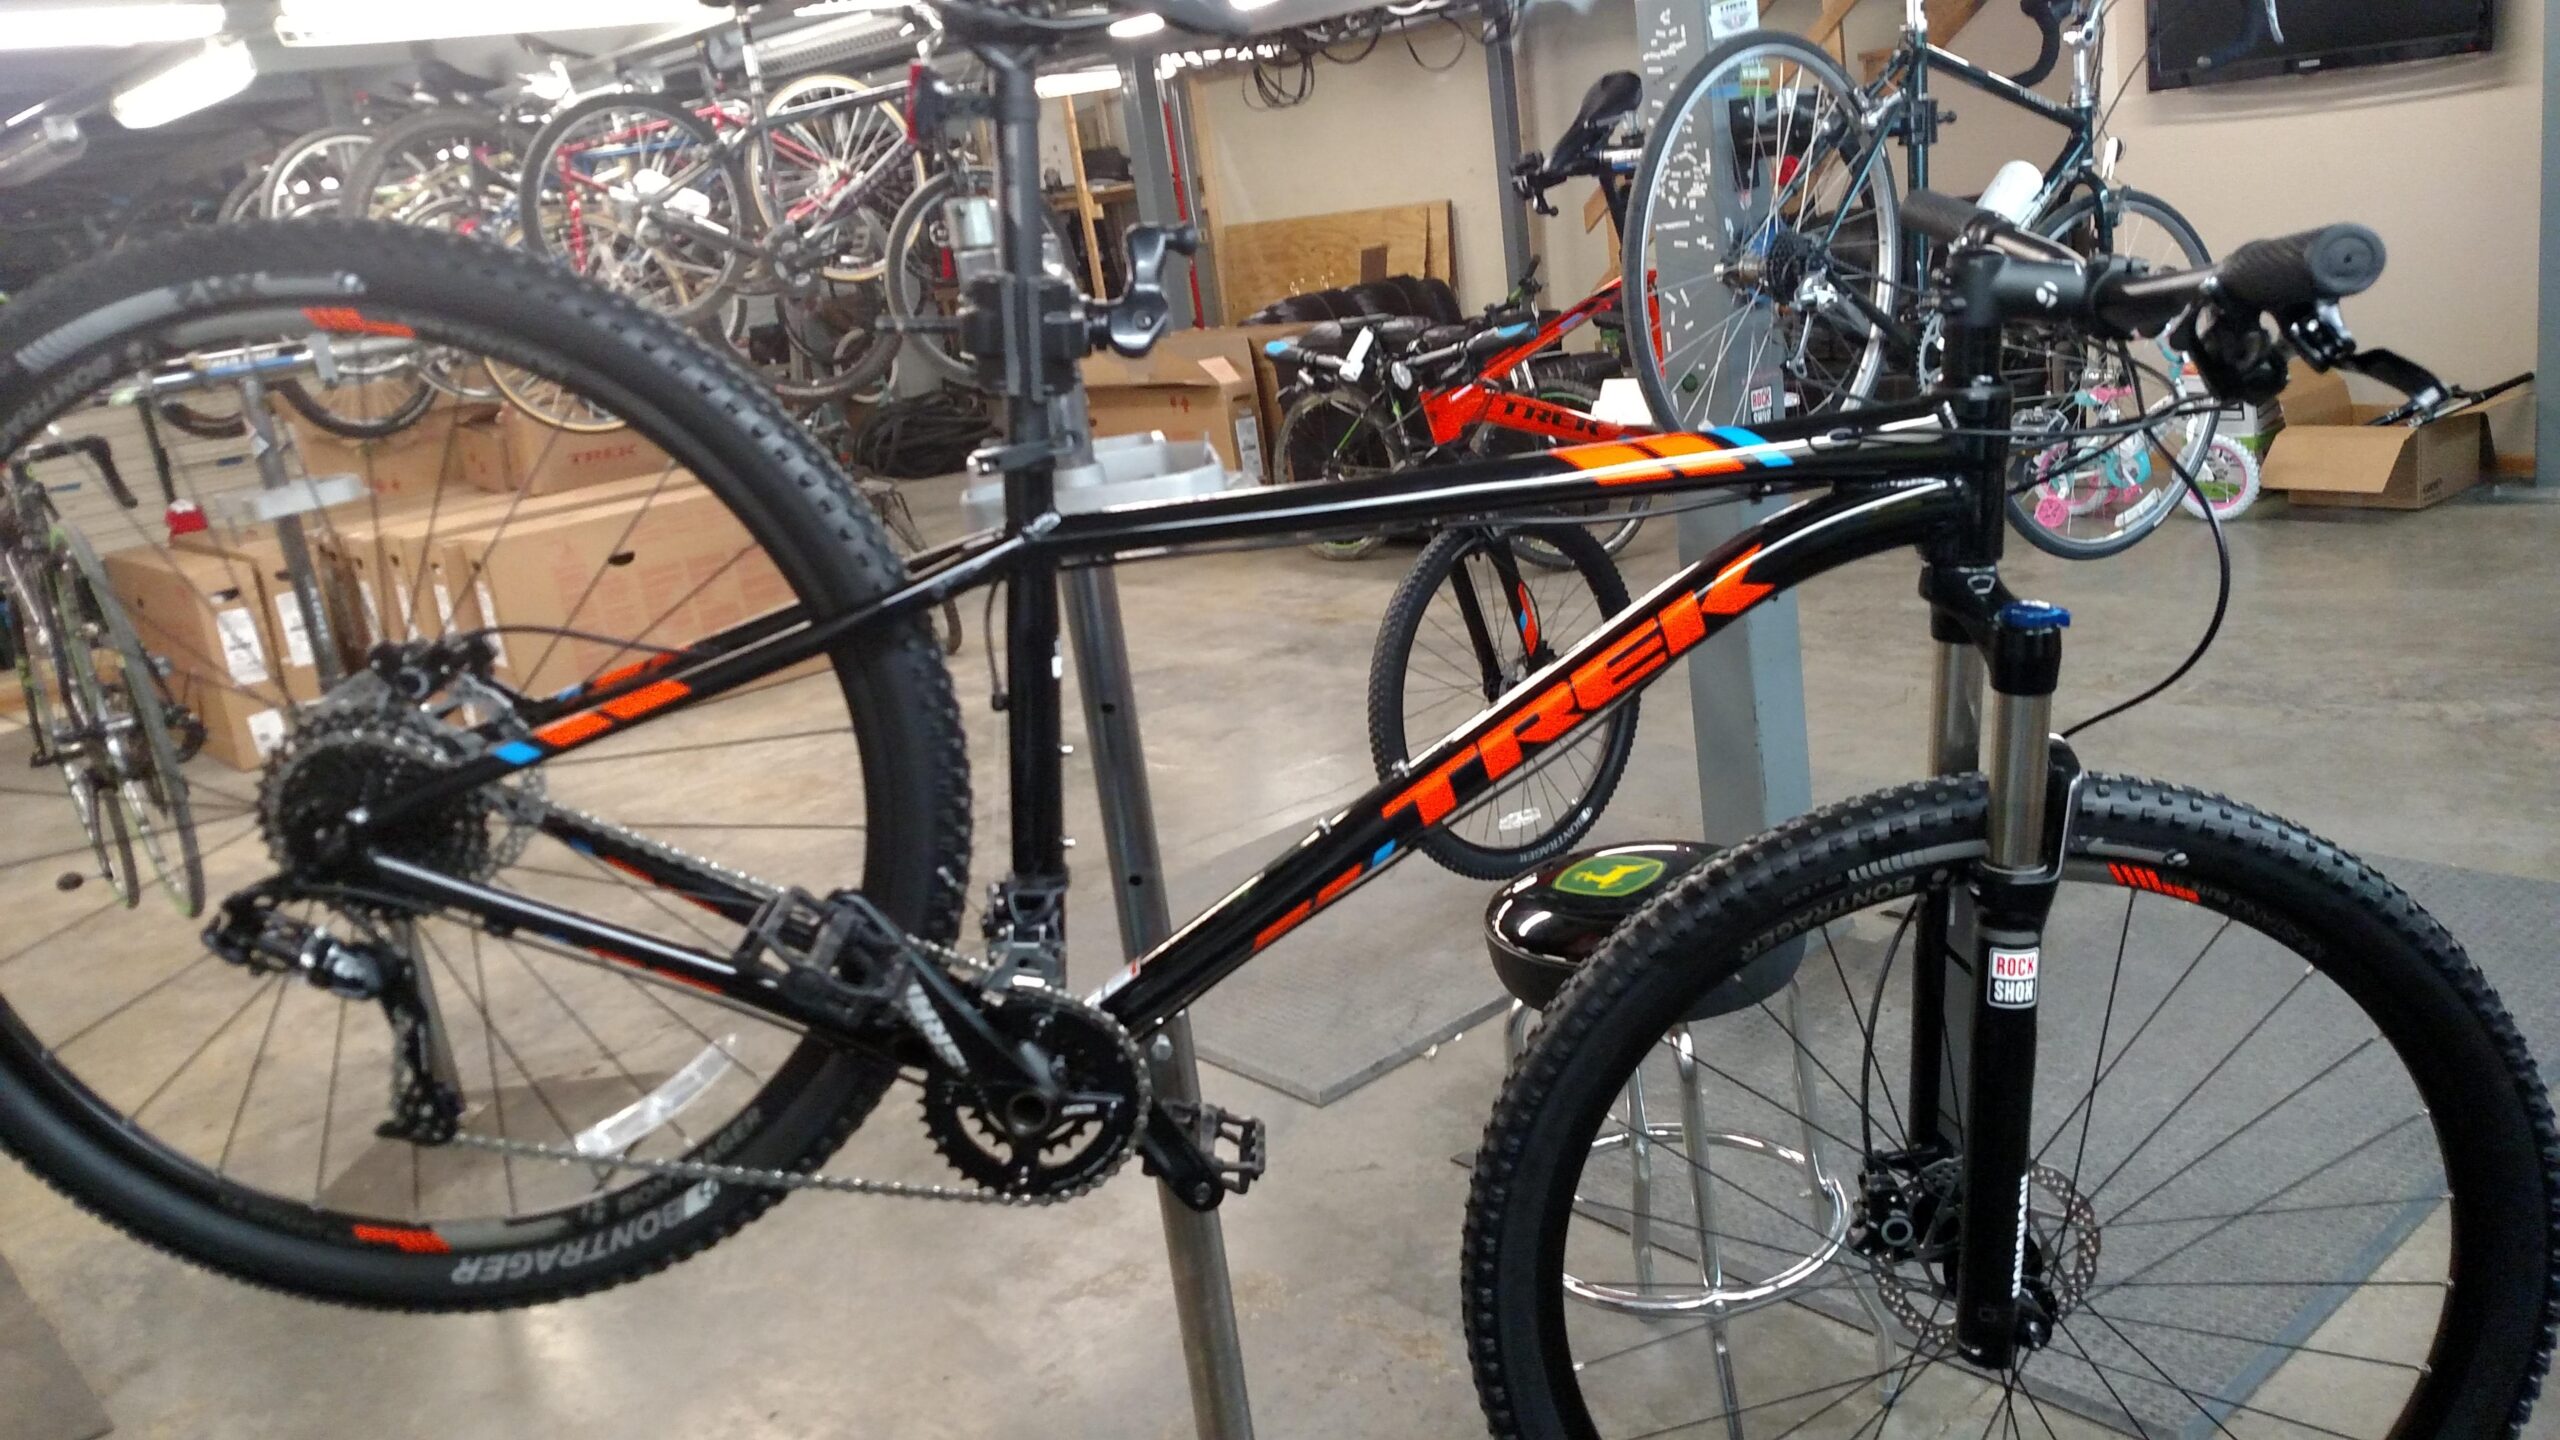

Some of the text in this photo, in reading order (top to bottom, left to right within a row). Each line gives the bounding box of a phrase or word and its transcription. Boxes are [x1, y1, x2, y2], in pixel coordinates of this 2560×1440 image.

[1505, 401, 1598, 436] TREK
[1381, 543, 1776, 827] TREK
[1742, 875, 1916, 962] BONTRAGER
[1994, 979, 2034, 1003] SHOX
[1996, 956, 2034, 976] ROCK
[451, 1195, 687, 1286] BONTRAGER
